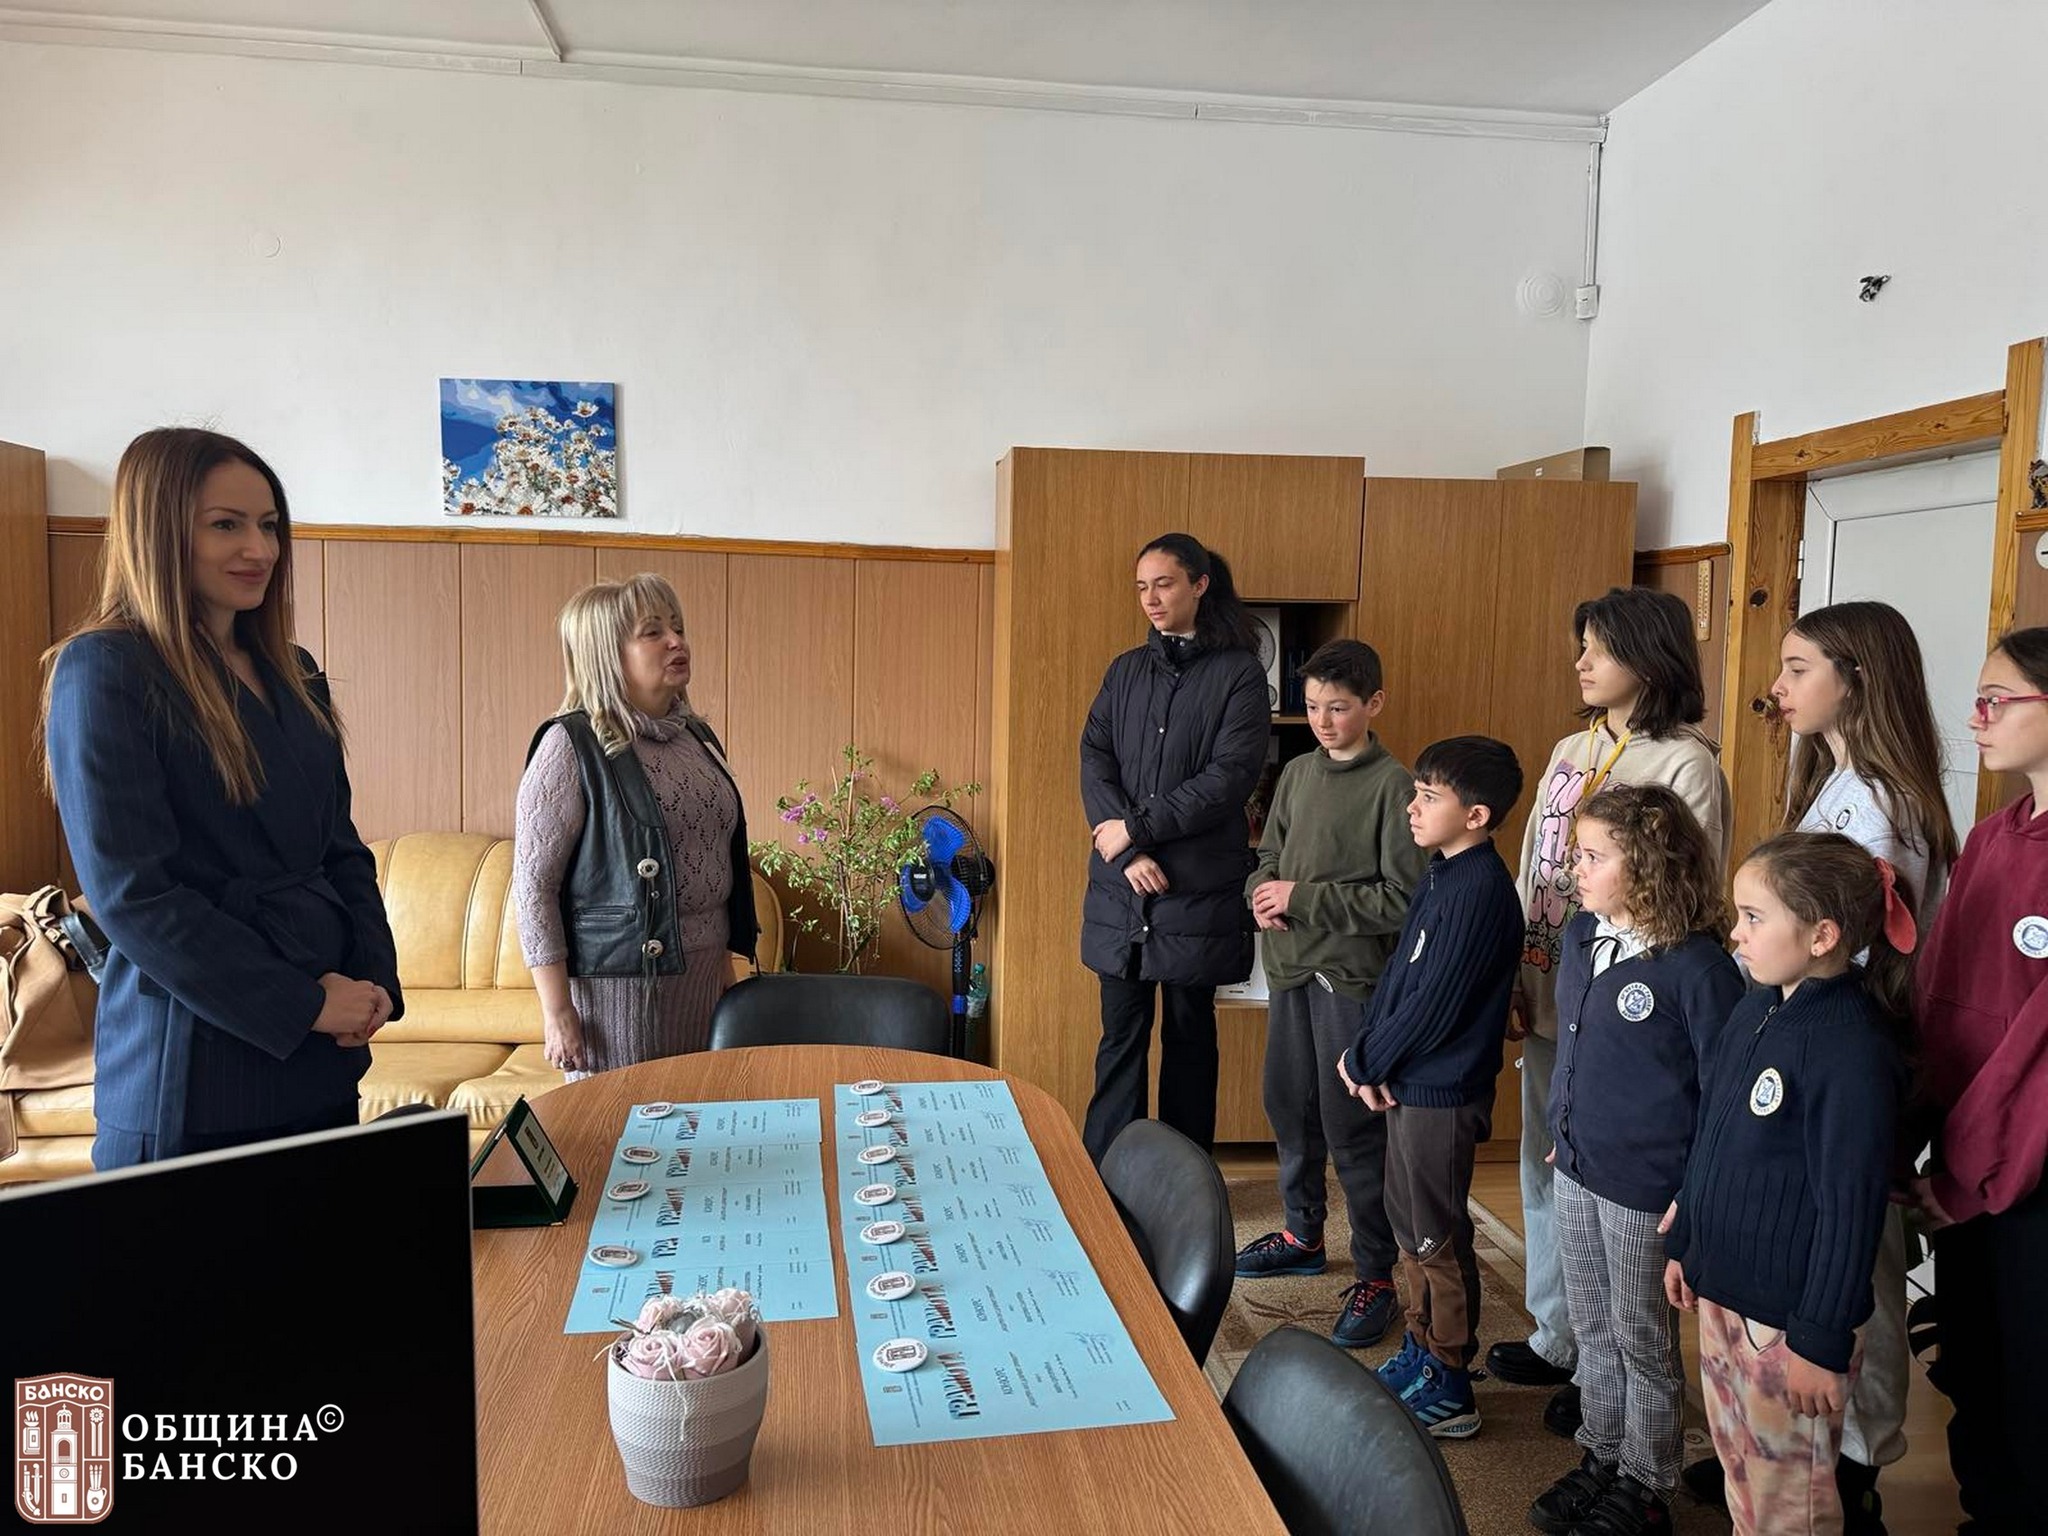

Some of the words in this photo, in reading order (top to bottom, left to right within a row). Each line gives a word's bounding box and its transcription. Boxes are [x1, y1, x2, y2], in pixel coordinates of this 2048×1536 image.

[666, 1148, 693, 1178] ГРАМОТ
[920, 1284, 958, 1340] ГРАМОТА
[936, 1351, 981, 1421] ГРАМОТА
